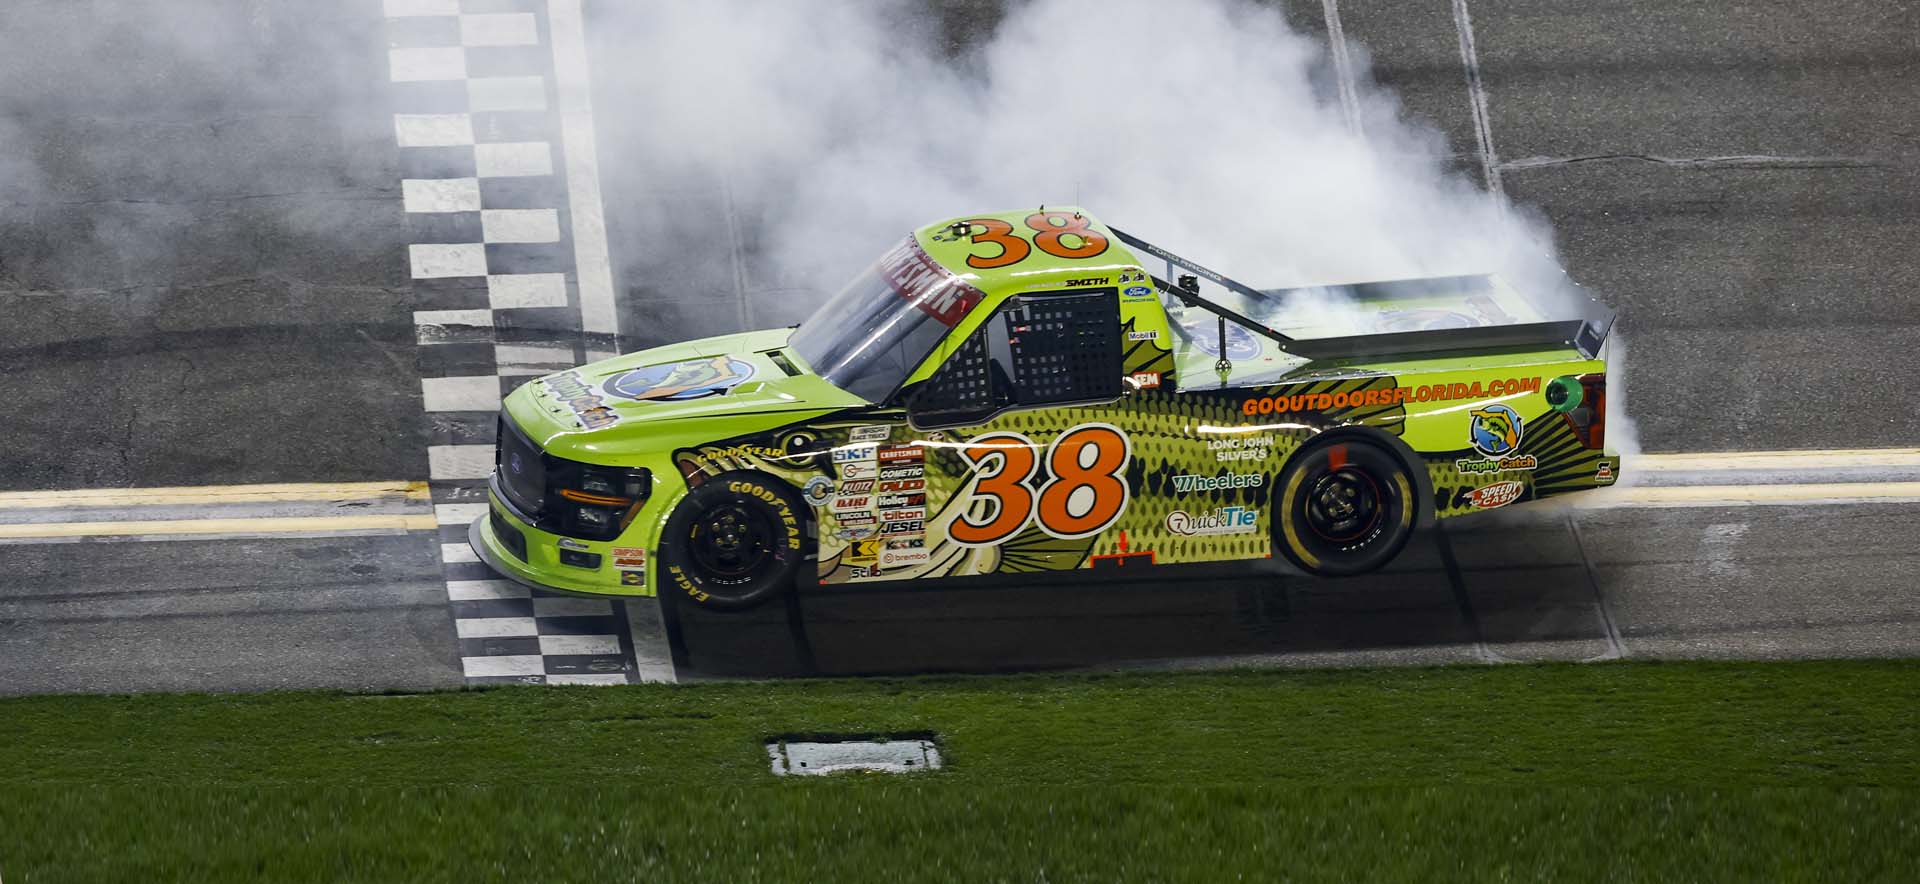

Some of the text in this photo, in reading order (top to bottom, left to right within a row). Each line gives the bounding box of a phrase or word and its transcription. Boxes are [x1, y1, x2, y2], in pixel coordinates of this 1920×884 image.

[966, 211, 1109, 269] 38
[1065, 277, 1109, 287] SMITH
[1129, 332, 1149, 340] Mobil
[1242, 377, 1541, 416] GOOUTDOORSFLORIDA.COM
[1207, 436, 1274, 450] LONG JOHN
[696, 444, 784, 463] GOODYEAR
[834, 447, 874, 461] SKF
[1216, 447, 1267, 461] SILVER'S
[1457, 456, 1536, 473] TrophyCatch
[880, 467, 924, 479] COMETIC
[841, 480, 874, 491] KLOTZ
[947, 424, 1130, 547] 38
[1172, 472, 1263, 492] Wheelers
[1481, 481, 1519, 499] SPEEDY
[879, 494, 909, 507] Holley
[1483, 491, 1518, 504] CASH
[729, 481, 801, 549] GOODYEAR
[882, 510, 923, 520] tilton
[1167, 506, 1257, 536] QuickTie
[881, 520, 926, 534] JESEL
[895, 553, 928, 561] brembo
[669, 566, 710, 601] EAGLE
